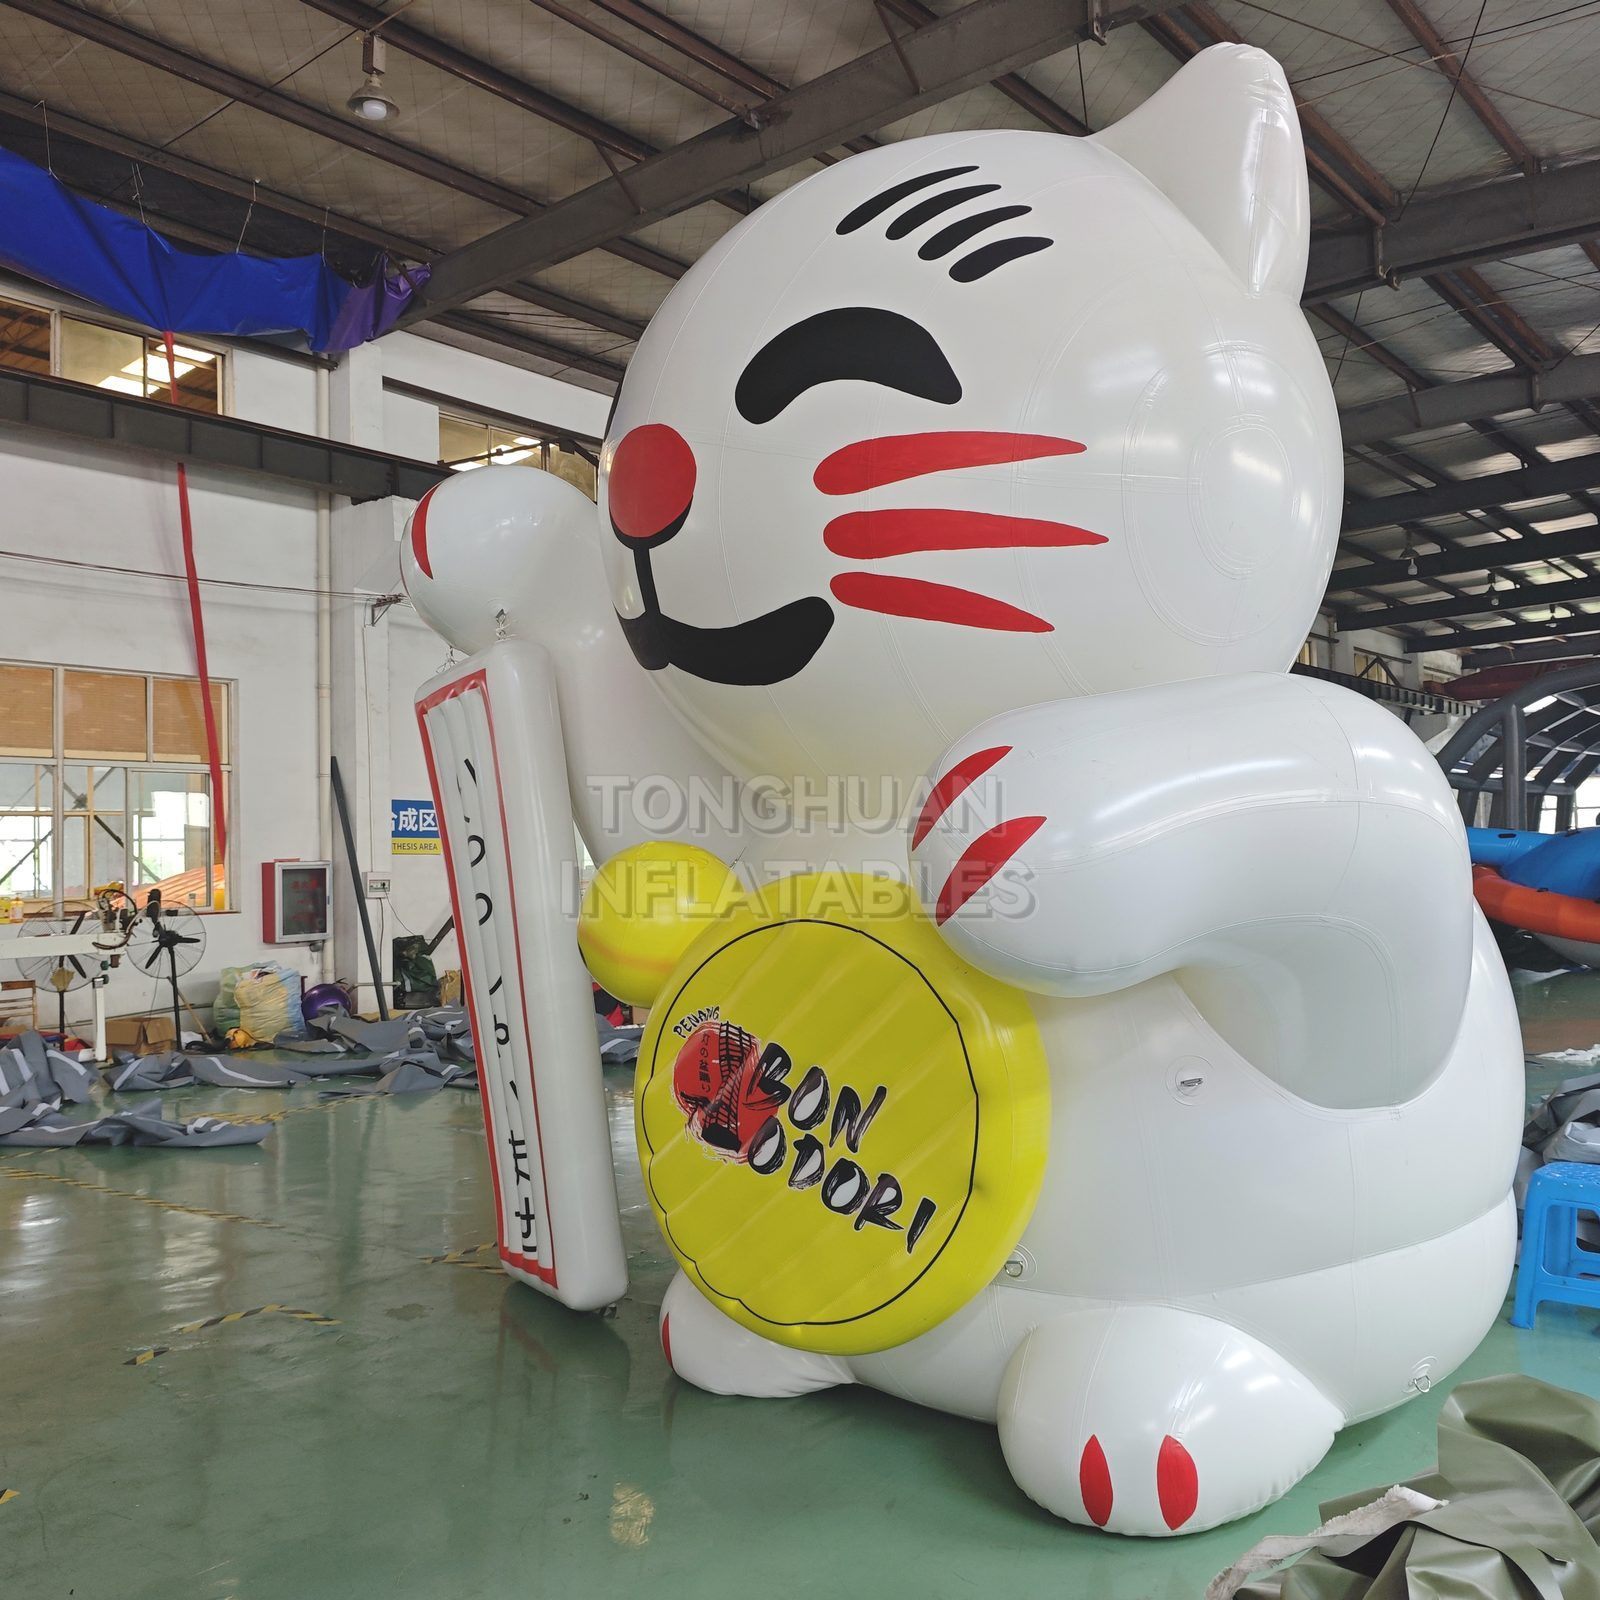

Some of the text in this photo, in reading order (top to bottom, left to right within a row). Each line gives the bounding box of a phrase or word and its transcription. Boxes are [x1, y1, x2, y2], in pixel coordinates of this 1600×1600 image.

[419, 843, 438, 851] AREA
[673, 1005, 720, 1039] PENANG
[743, 1042, 888, 1154] BON
[748, 1115, 938, 1255] ODORI
